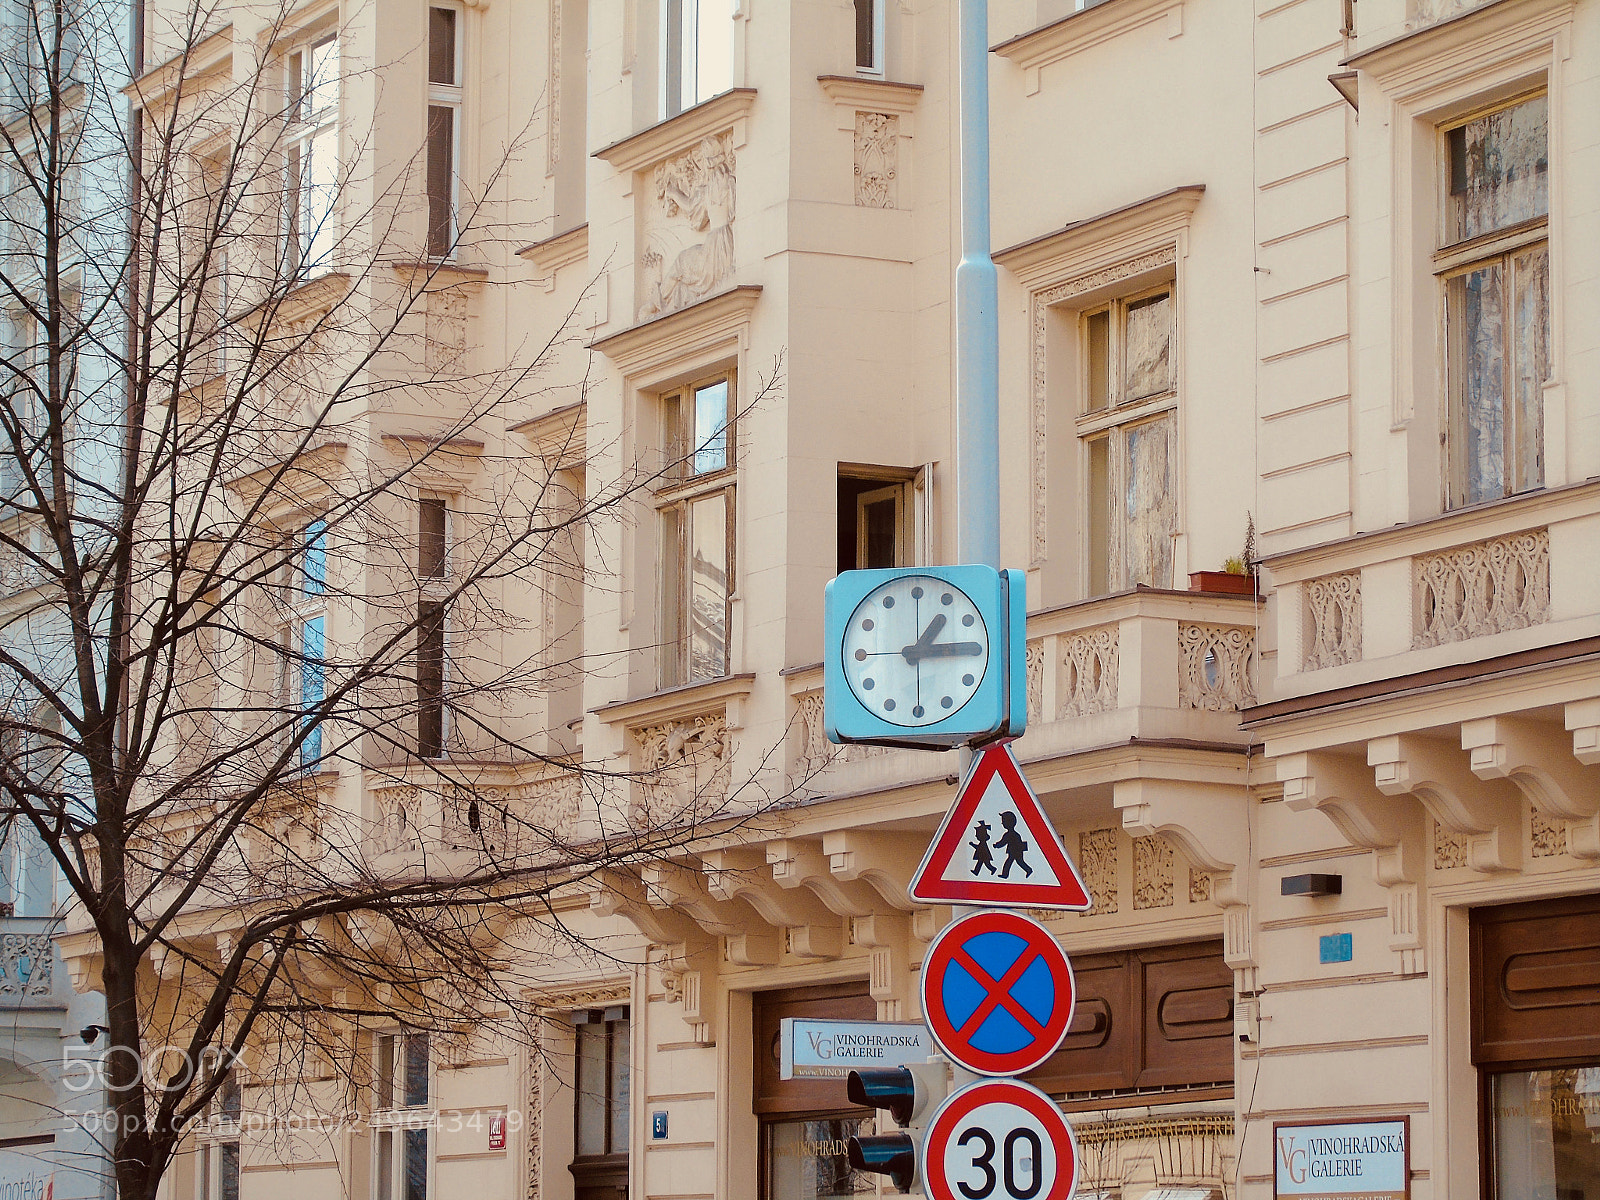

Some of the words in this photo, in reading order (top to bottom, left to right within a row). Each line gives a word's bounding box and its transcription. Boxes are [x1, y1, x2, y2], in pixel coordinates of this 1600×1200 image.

[836, 1034, 920, 1047] VINOHRADSKÁ
[836, 1046, 884, 1058] GALERIE
[1310, 1131, 1404, 1156] VINOHRADSKÁ
[957, 1127, 1042, 1200] 30
[1311, 1158, 1363, 1178] GALERIE
